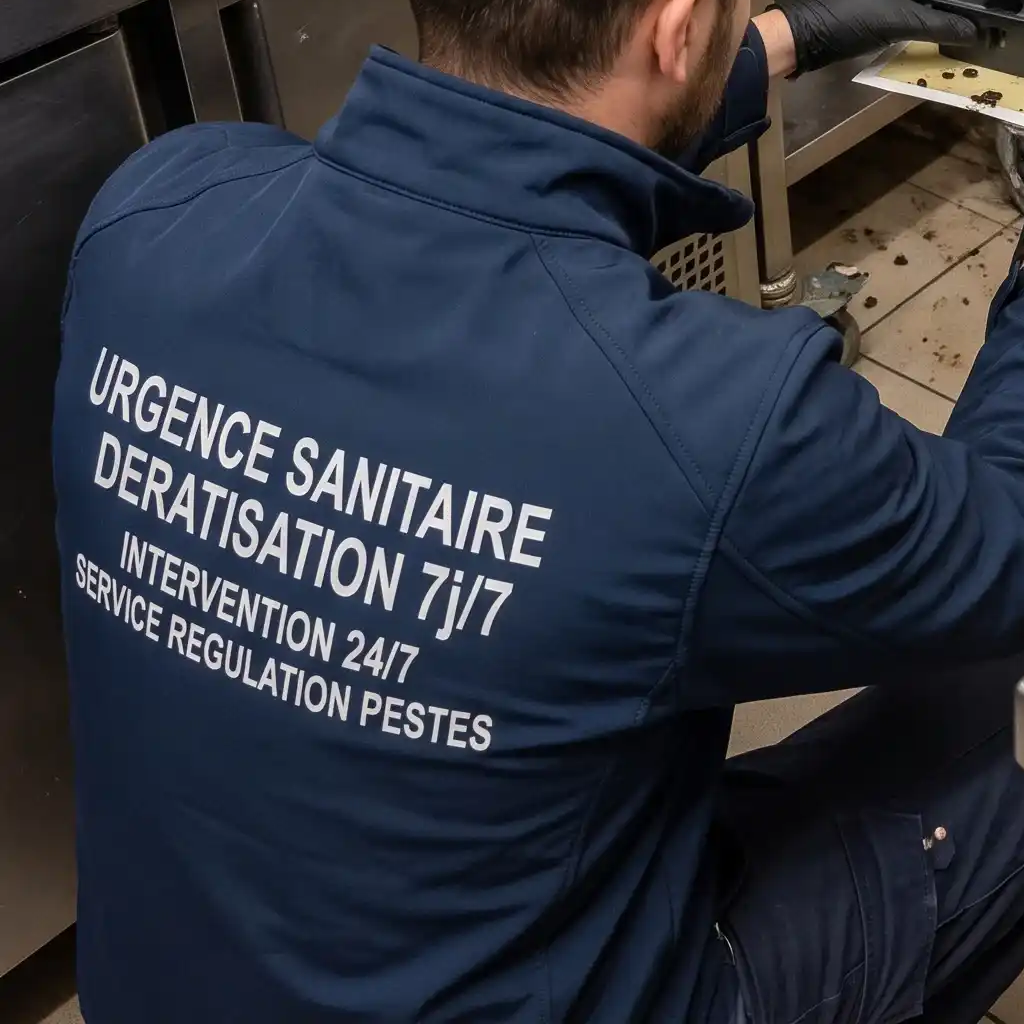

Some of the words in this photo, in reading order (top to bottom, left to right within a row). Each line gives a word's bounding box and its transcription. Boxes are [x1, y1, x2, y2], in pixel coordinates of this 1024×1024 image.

[89, 346, 282, 483] URGENCE
[286, 436, 553, 569] SANITAIRE
[94, 431, 405, 612] DERATISATION
[417, 561, 514, 641] 7j/7
[75, 552, 163, 642] SERVICE
[167, 614, 351, 721] REGULATION
[360, 690, 493, 752] PESTES
[120, 530, 336, 663] INTERVENTION
[342, 629, 420, 684] 24/7
